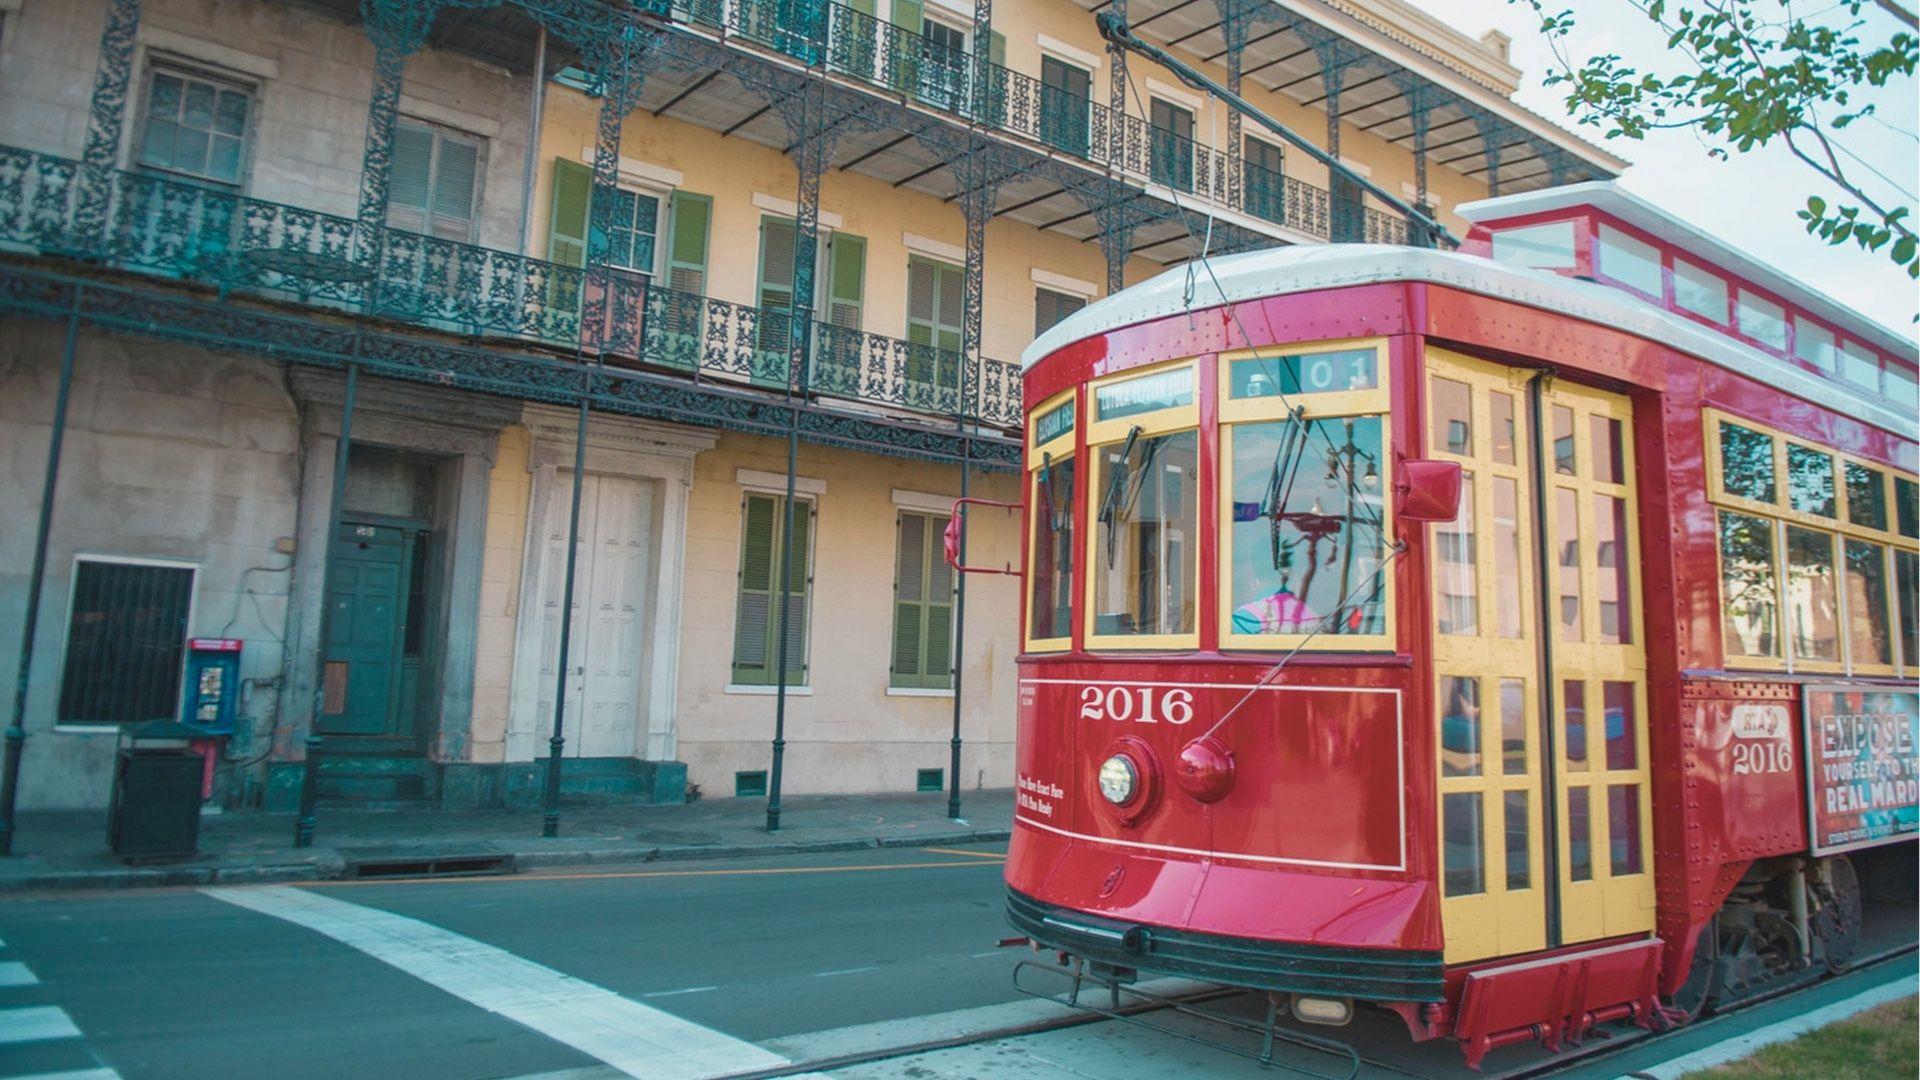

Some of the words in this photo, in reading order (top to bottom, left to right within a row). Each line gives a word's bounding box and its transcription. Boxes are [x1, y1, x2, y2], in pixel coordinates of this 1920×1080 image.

[1080, 686, 1194, 724] 2016
[1821, 713, 1911, 758] EXPOSE
[1732, 742, 1792, 775] 2016
[1823, 759, 1879, 782] YOURSELF
[1885, 757, 1901, 776] TO
[1826, 783, 1869, 813] REAL
